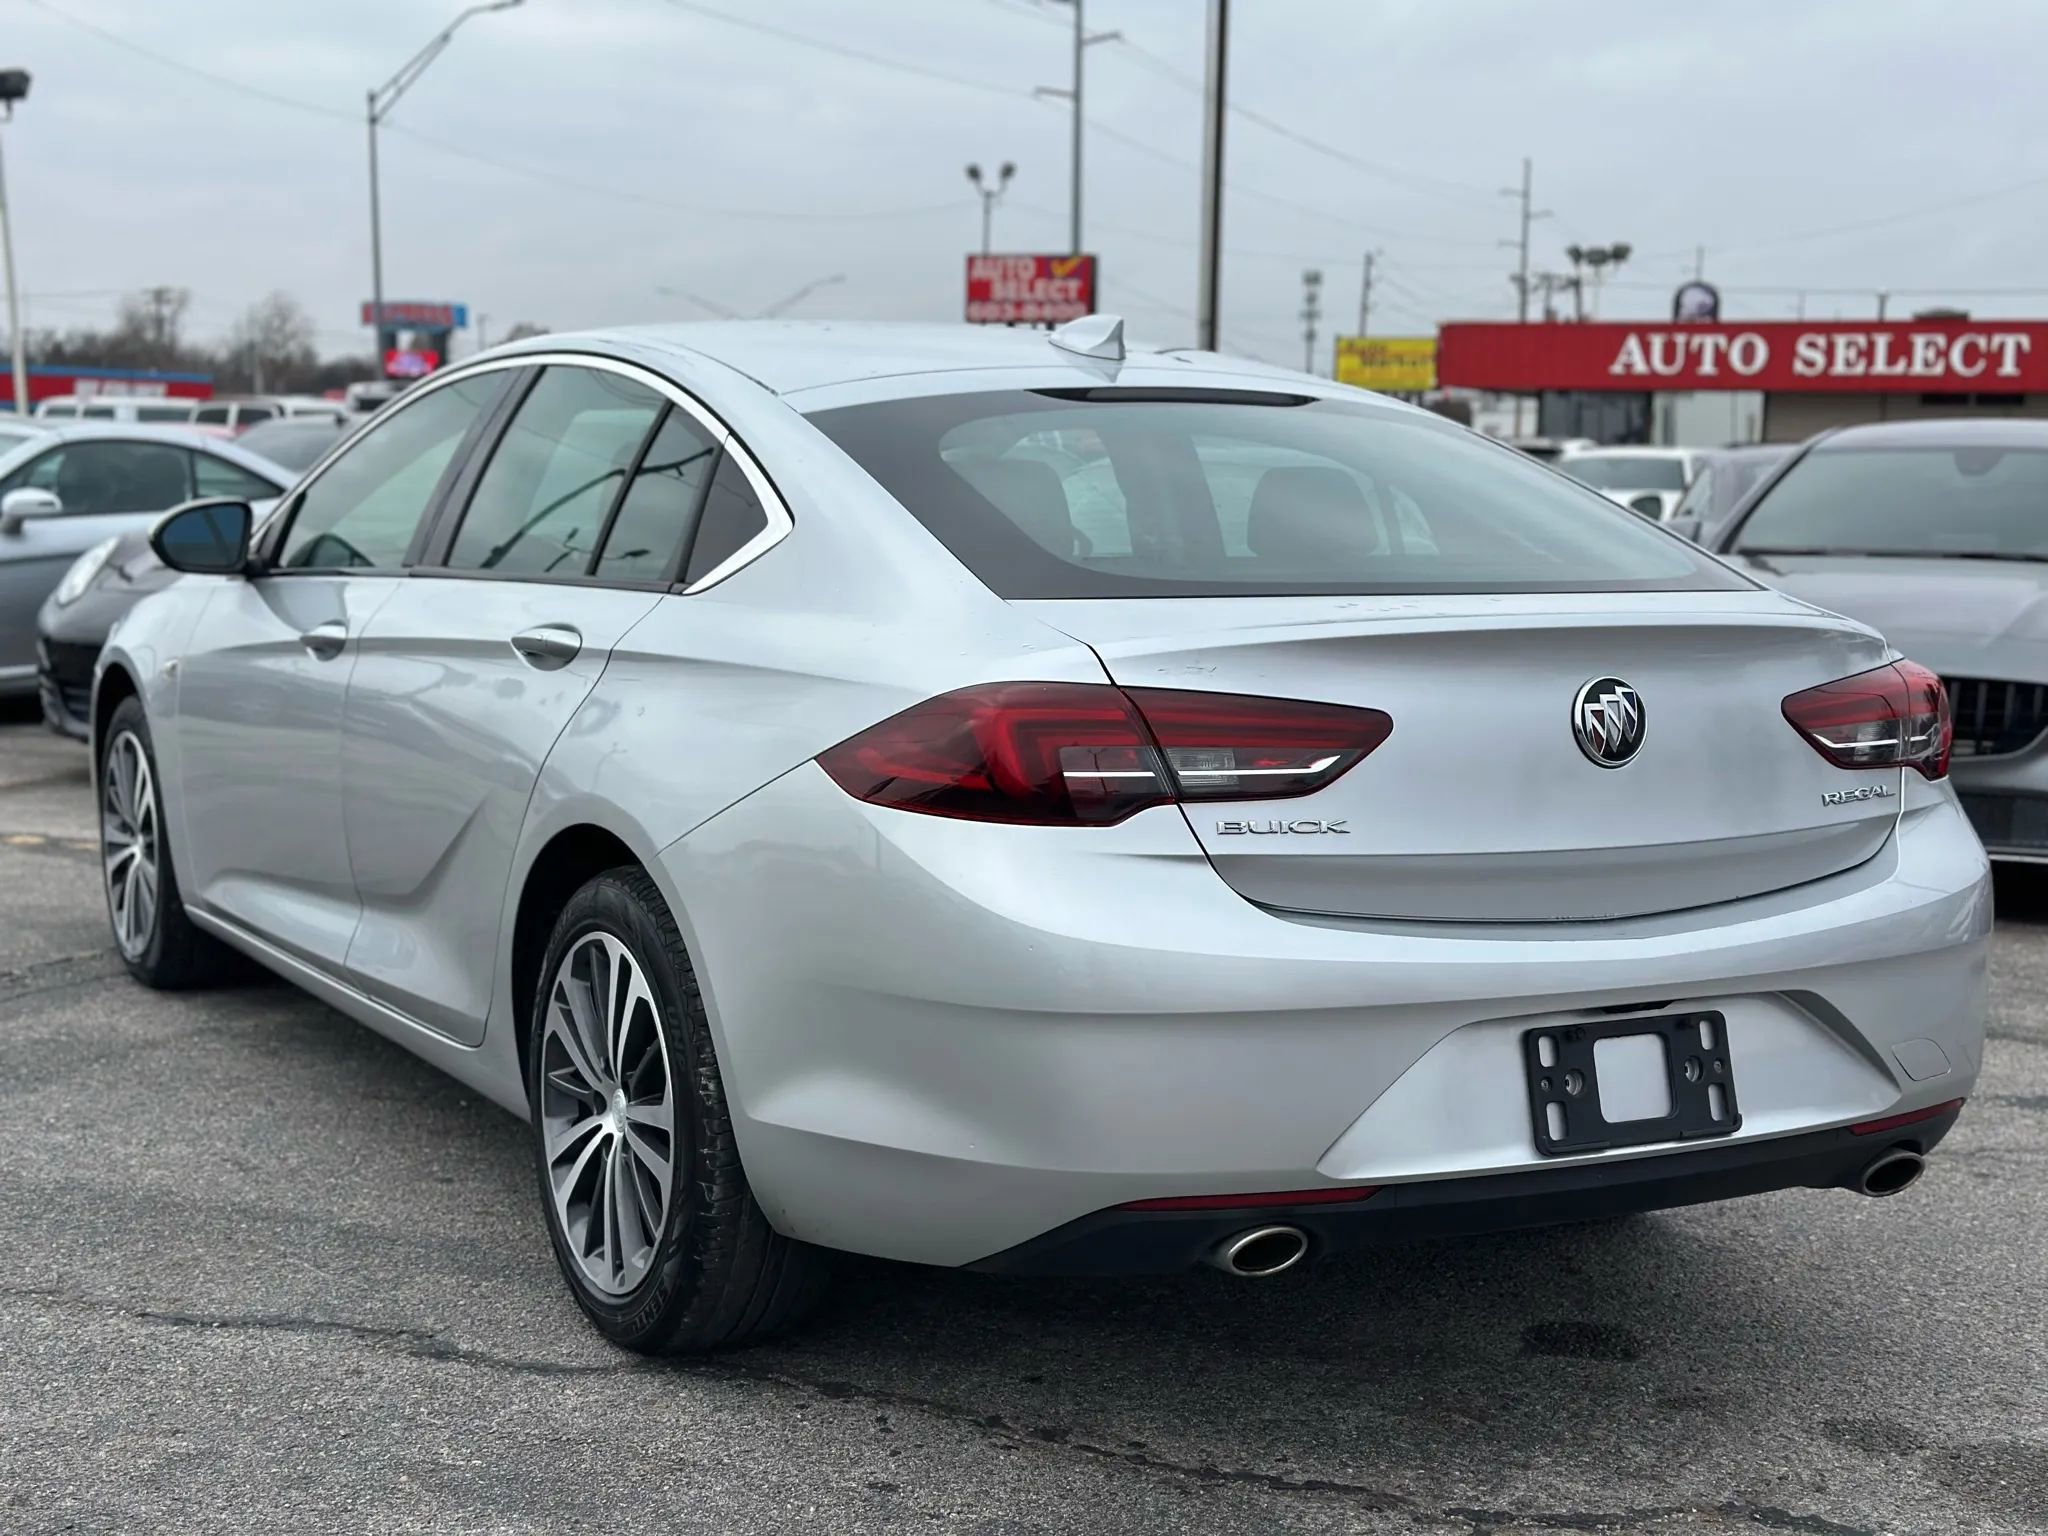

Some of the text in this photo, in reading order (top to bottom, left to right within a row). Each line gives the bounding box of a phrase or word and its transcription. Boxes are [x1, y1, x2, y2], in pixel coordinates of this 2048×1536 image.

[971, 256, 1037, 280] AUTO
[990, 278, 1083, 301] SELECT
[1608, 331, 2031, 377] AUTO SELECT
[1821, 784, 1896, 807] REGAL
[1216, 820, 1351, 835] BUICK
